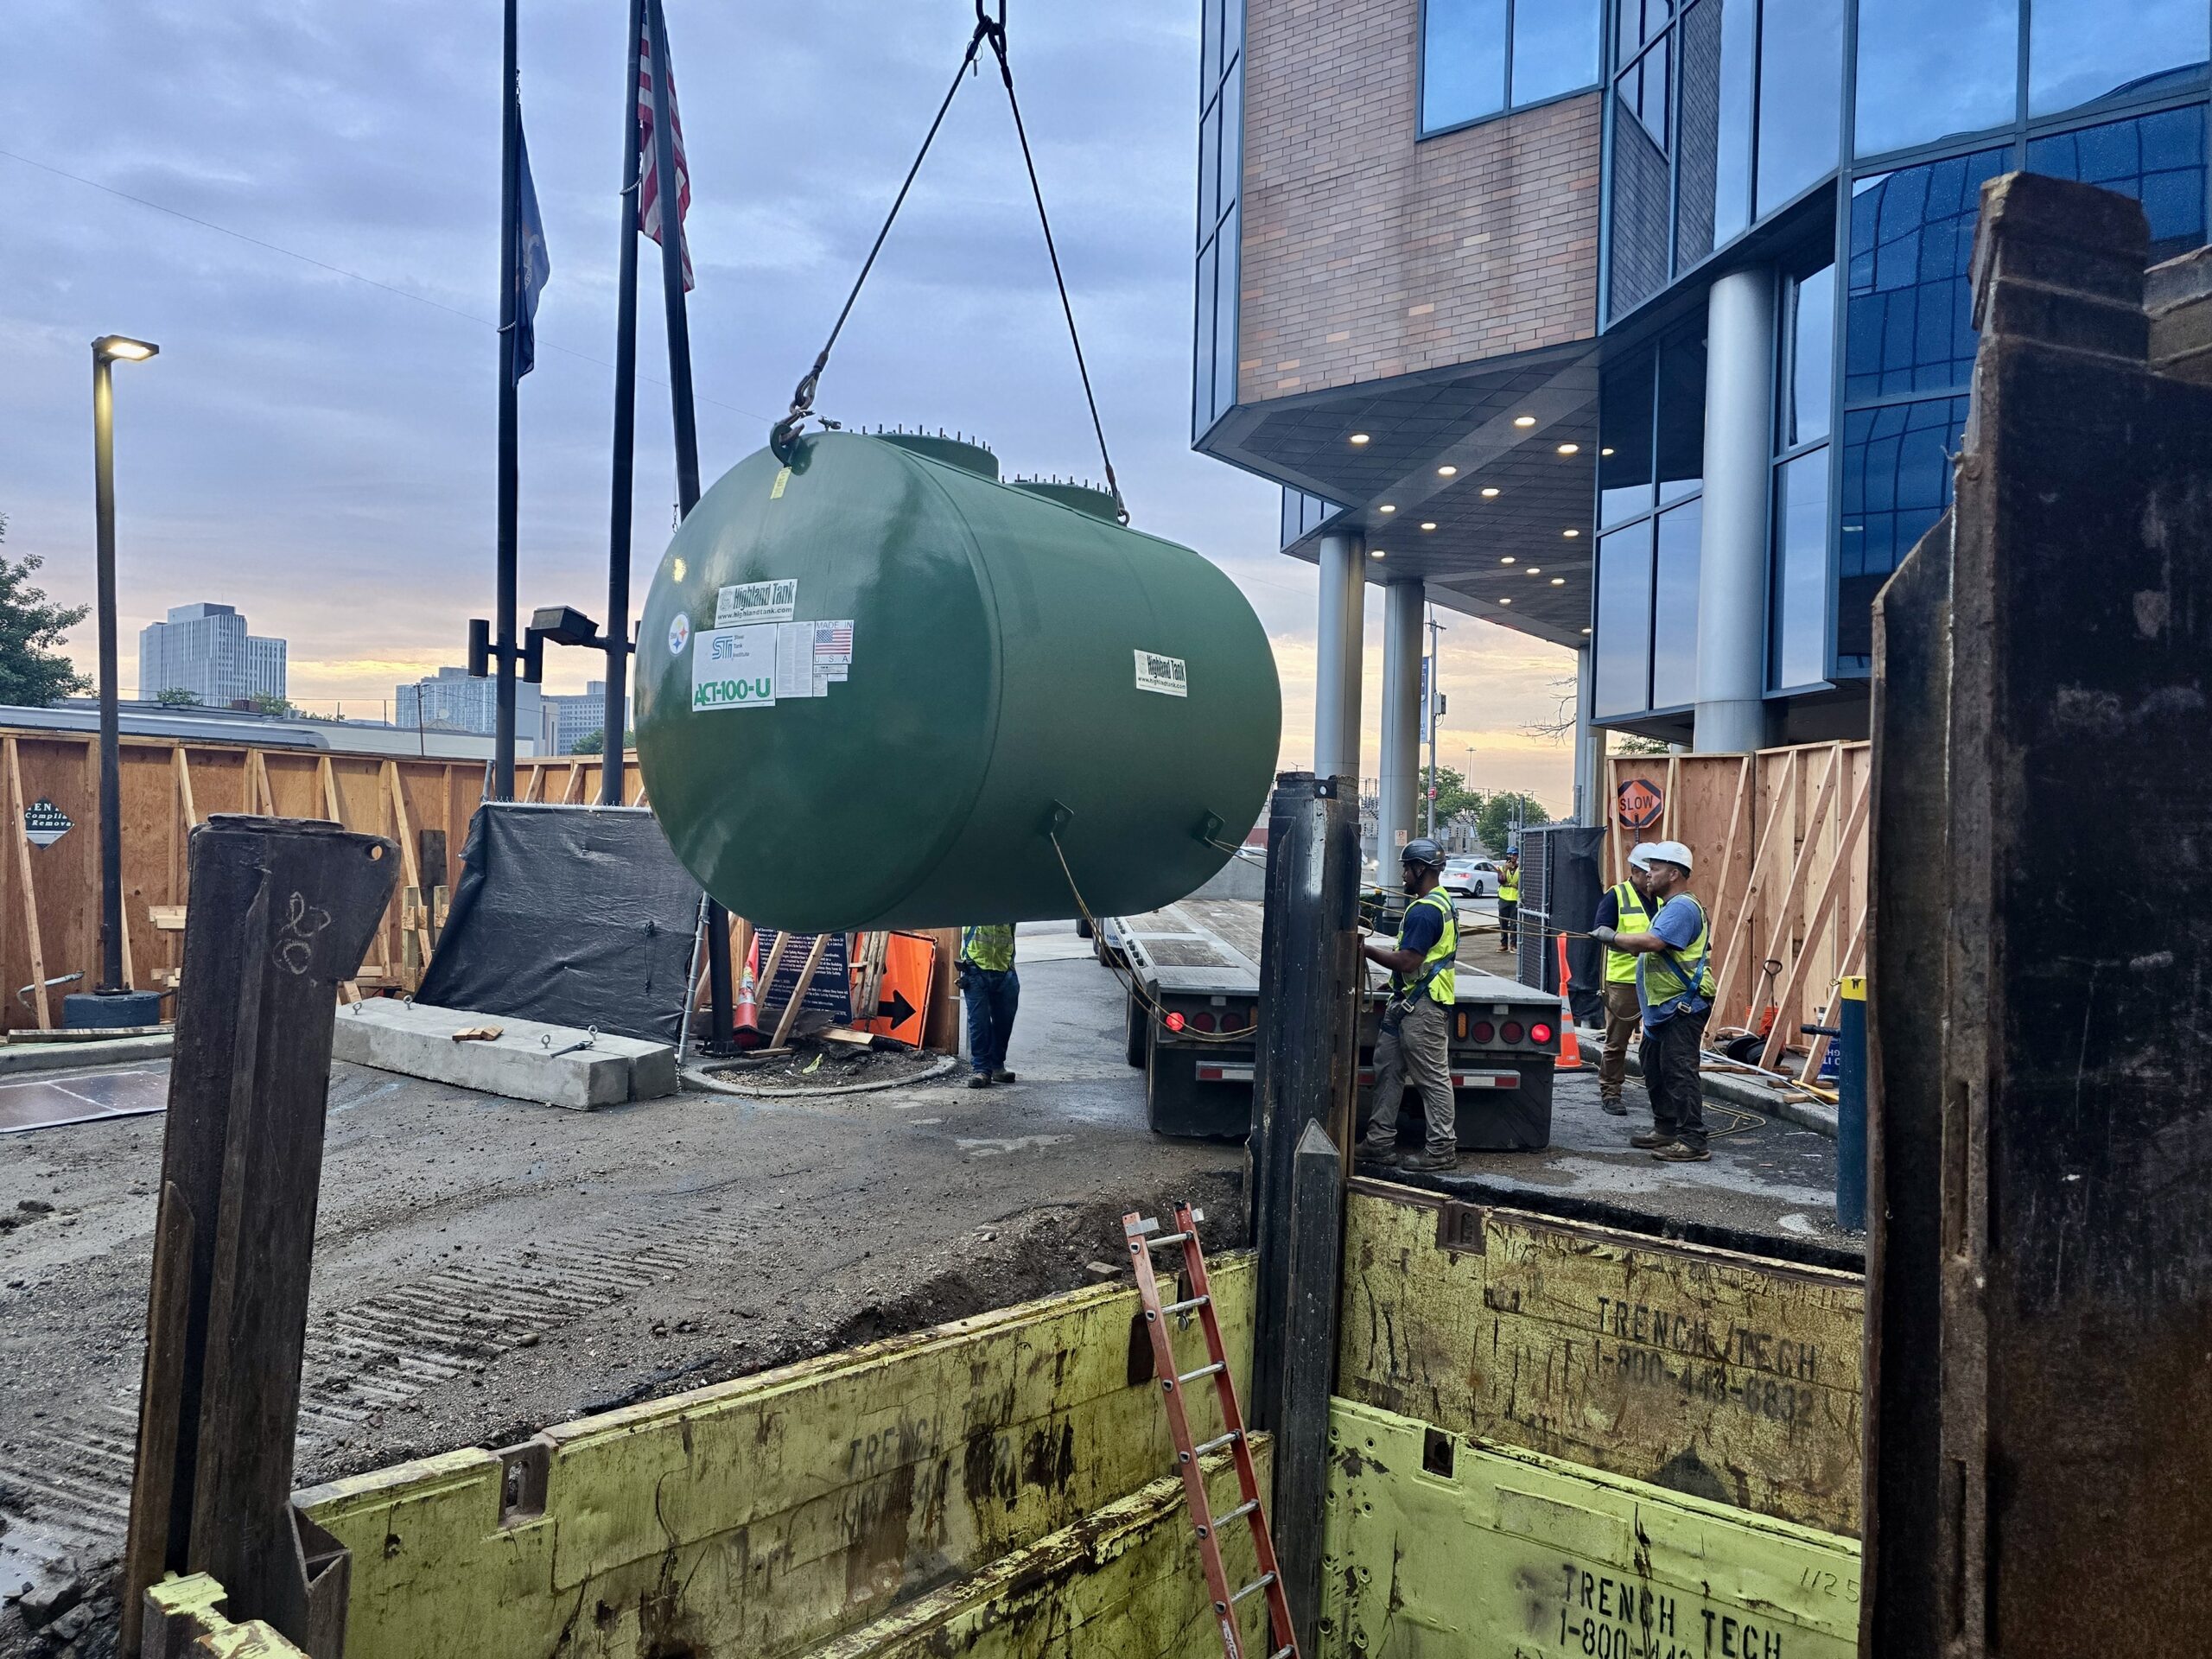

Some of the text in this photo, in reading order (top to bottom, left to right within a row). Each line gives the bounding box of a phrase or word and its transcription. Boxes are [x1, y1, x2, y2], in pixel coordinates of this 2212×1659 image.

[733, 584, 771, 611] Highland
[772, 582, 795, 604] Tank
[717, 607, 792, 620] www.highlandtank.com
[816, 620, 852, 629] MADE IN
[1147, 655, 1185, 681] Highland Tank
[694, 678, 771, 706] ACT-100-U
[1620, 795, 1653, 811] SLOW
[1599, 1296, 1709, 1357] TRENCH
[1801, 1566, 1859, 1603] 1125
[1701, 1608, 1781, 1659] TECH
